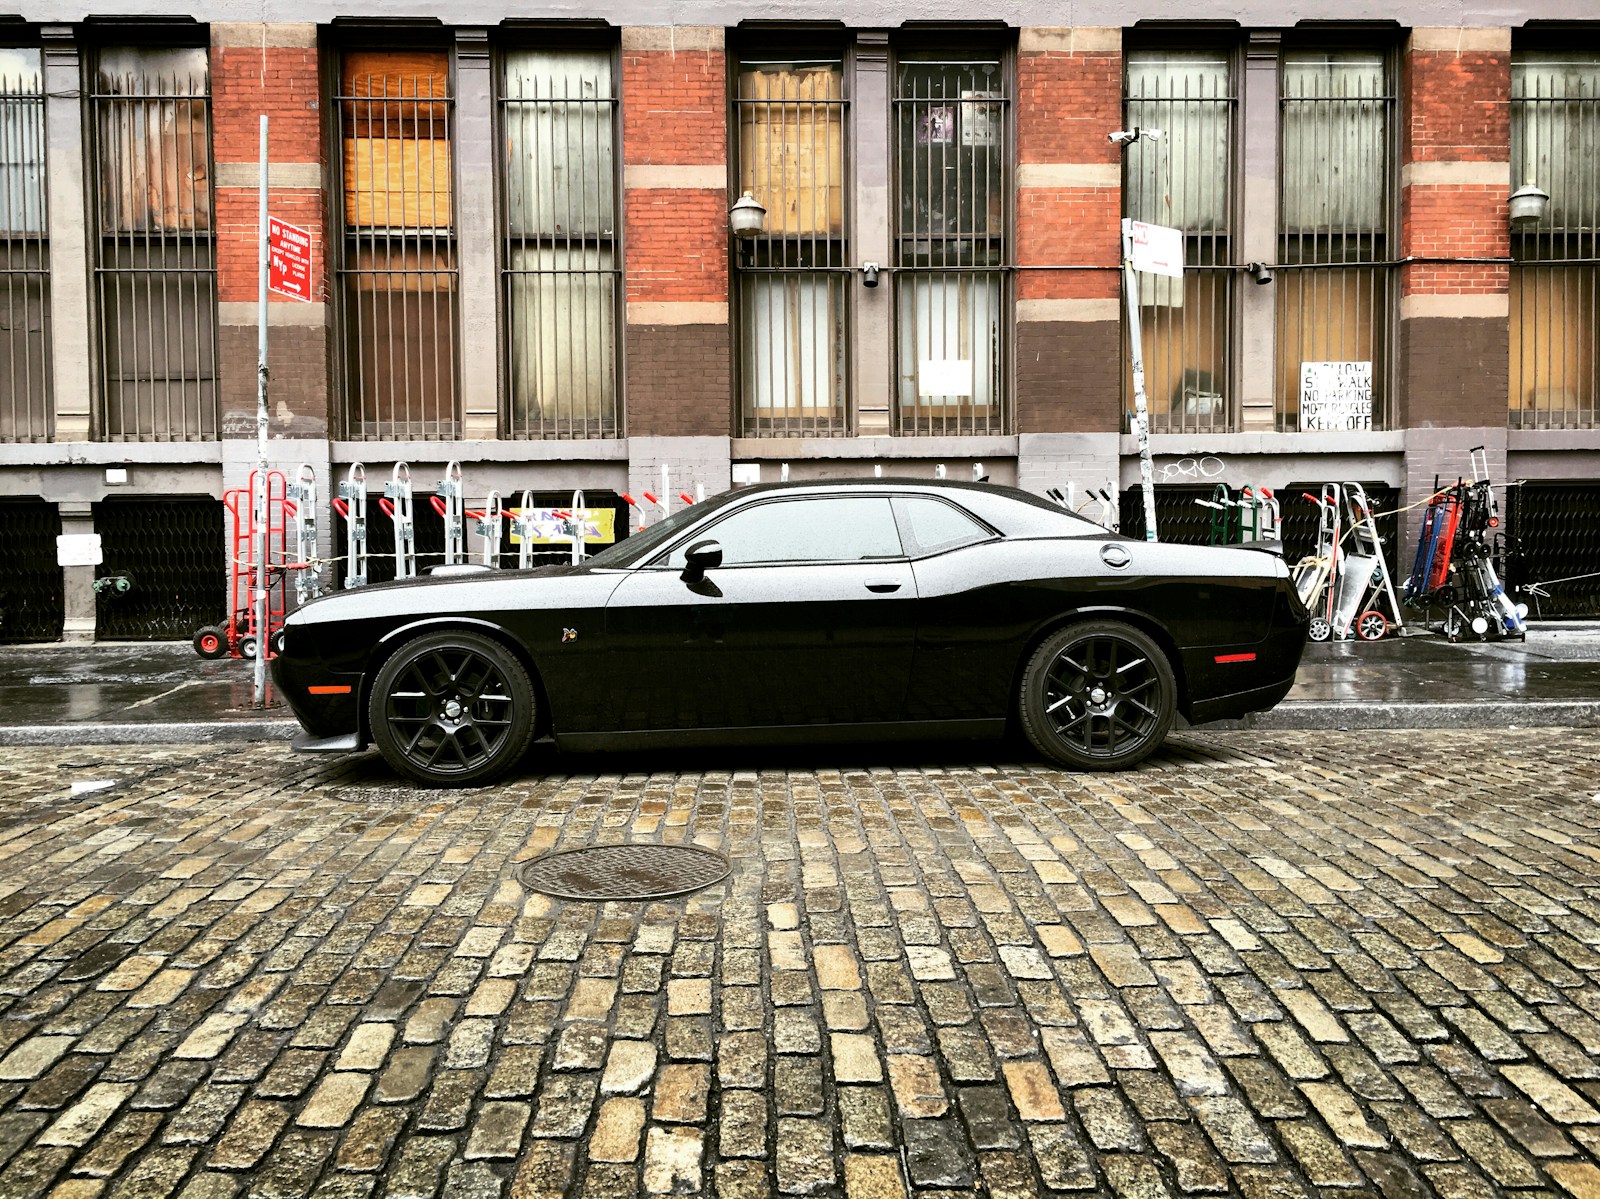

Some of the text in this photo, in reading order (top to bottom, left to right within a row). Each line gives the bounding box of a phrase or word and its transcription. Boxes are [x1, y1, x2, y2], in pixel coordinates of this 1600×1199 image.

[271, 224, 308, 247] NO STANDING
[280, 240, 301, 254] ANYTIME
[273, 255, 287, 276] NYP
[1303, 390, 1319, 401] NO
[1307, 415, 1371, 430] KE OFF
